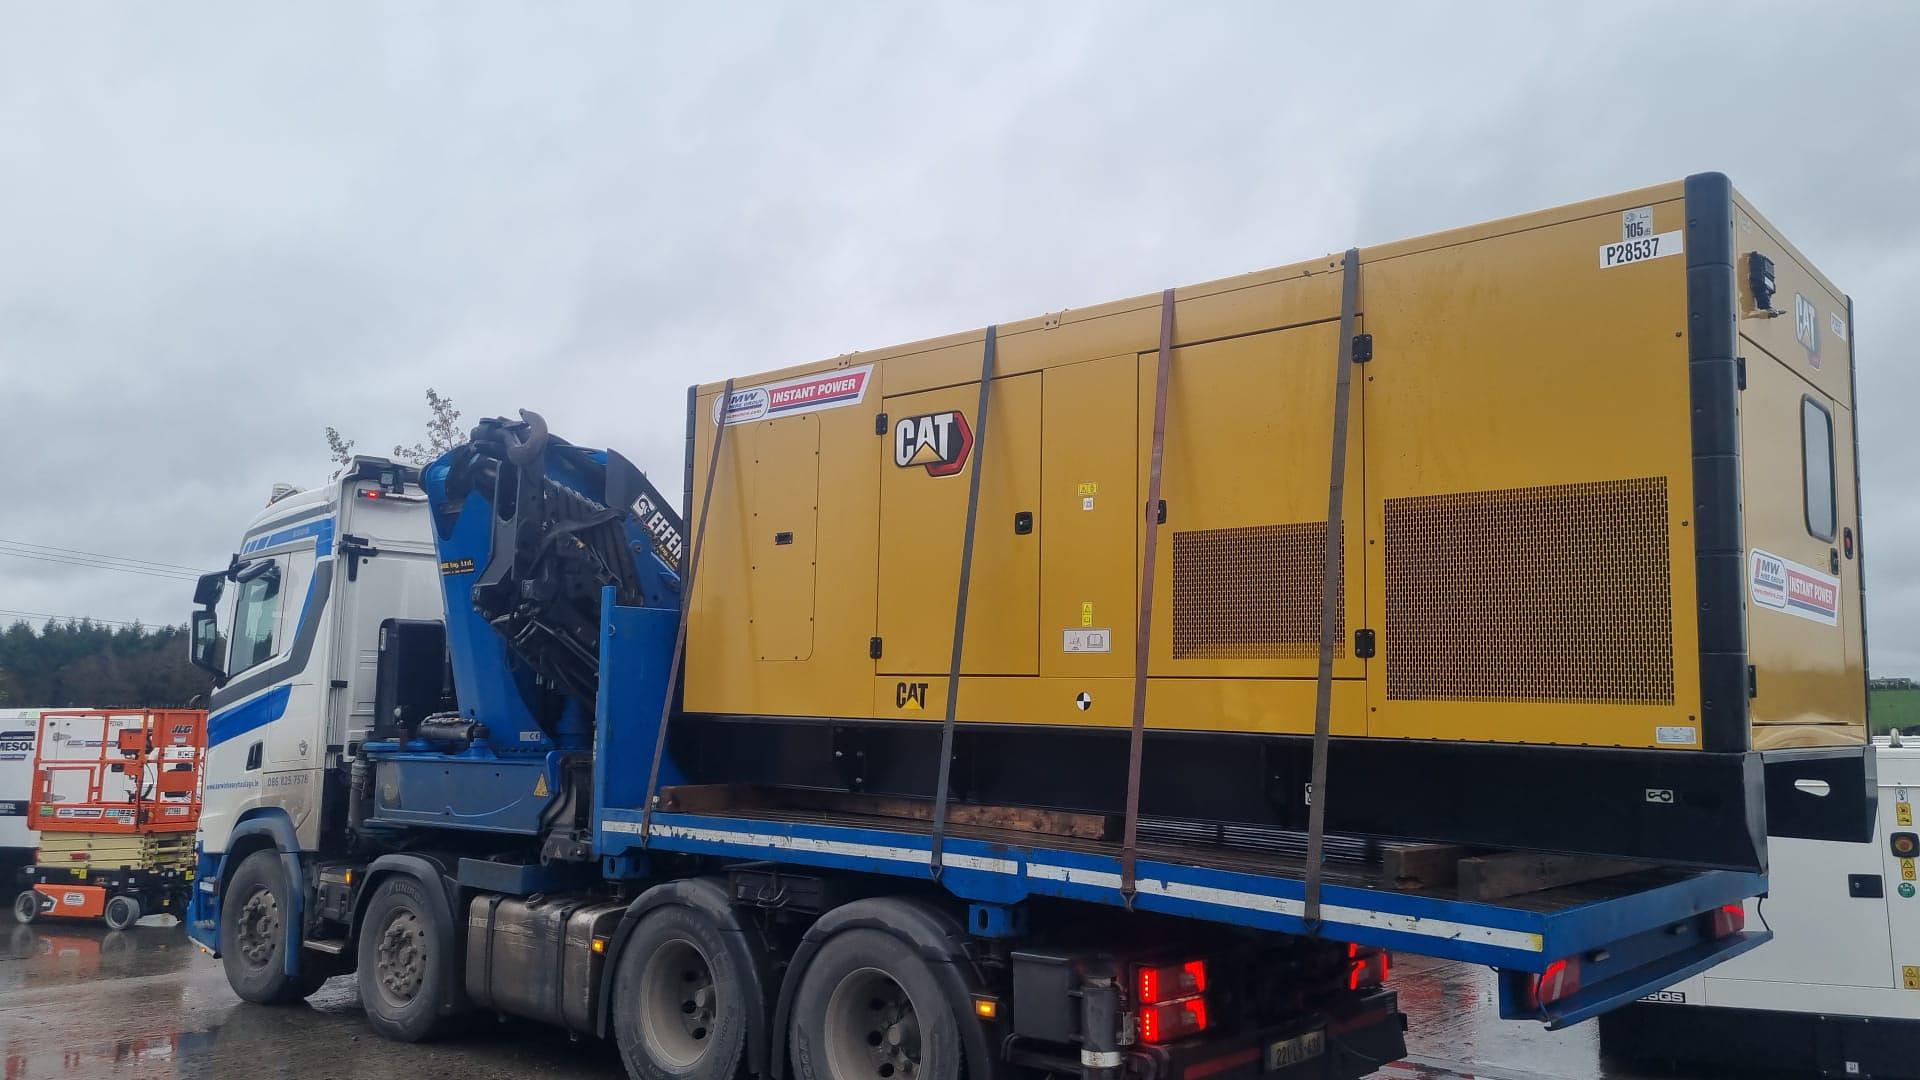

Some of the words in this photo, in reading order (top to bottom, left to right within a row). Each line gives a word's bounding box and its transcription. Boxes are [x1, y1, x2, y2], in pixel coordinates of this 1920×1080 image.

[1625, 221, 1644, 238] 105
[1606, 238, 1660, 266] P28537
[1795, 293, 1815, 353] CAT
[731, 391, 759, 404] MW
[772, 387, 814, 404] INSTANT
[817, 378, 856, 396] POWER
[896, 411, 955, 468] CAT
[1761, 560, 1781, 575] MW
[1789, 575, 1814, 598] INSTANT
[1814, 586, 1834, 605] POWER
[896, 682, 929, 710] CAT
